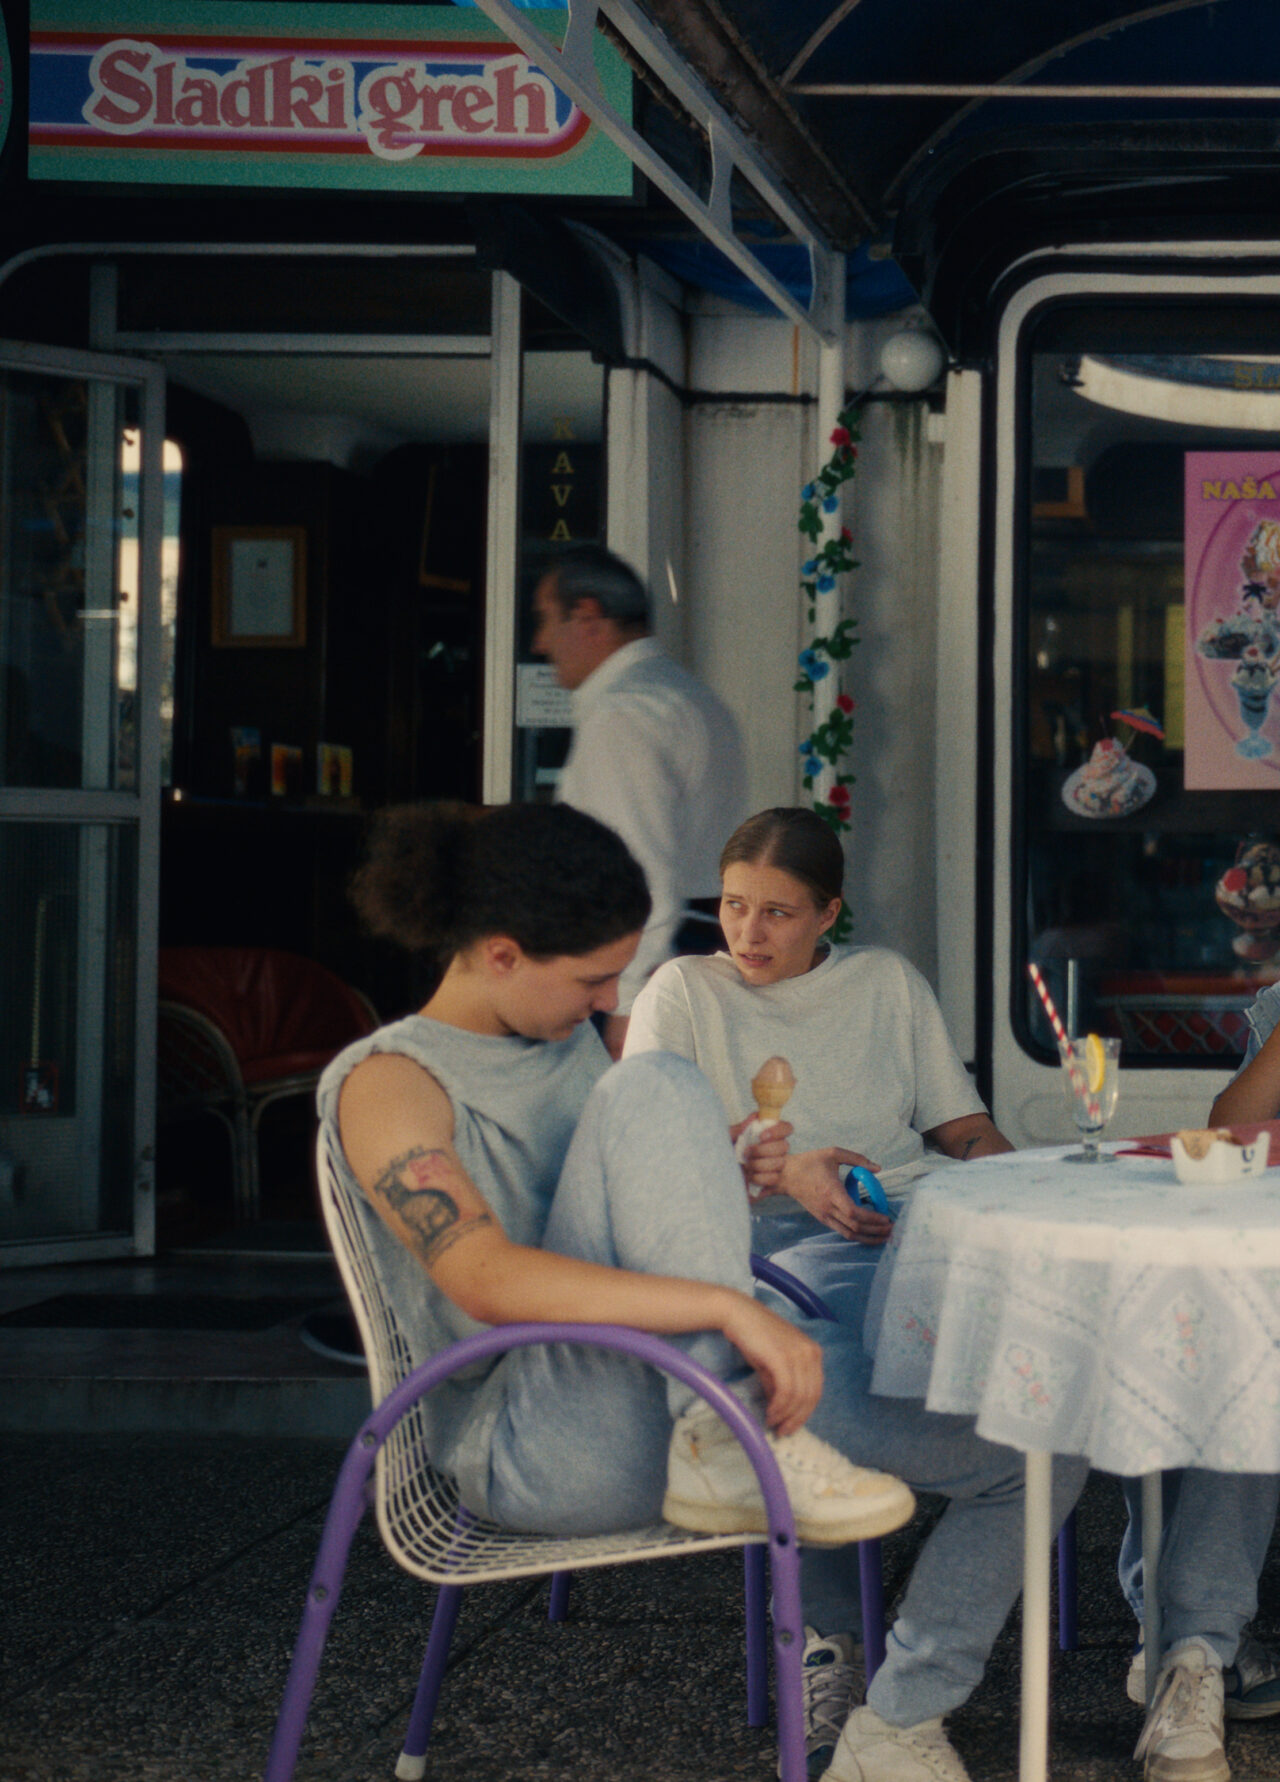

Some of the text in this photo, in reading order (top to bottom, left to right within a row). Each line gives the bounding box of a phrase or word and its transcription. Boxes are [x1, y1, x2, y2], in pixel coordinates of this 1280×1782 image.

[92, 48, 348, 130] Sladki
[367, 63, 550, 151] greh
[550, 416, 575, 541] KAVA
[1202, 476, 1278, 500] NAŠA
